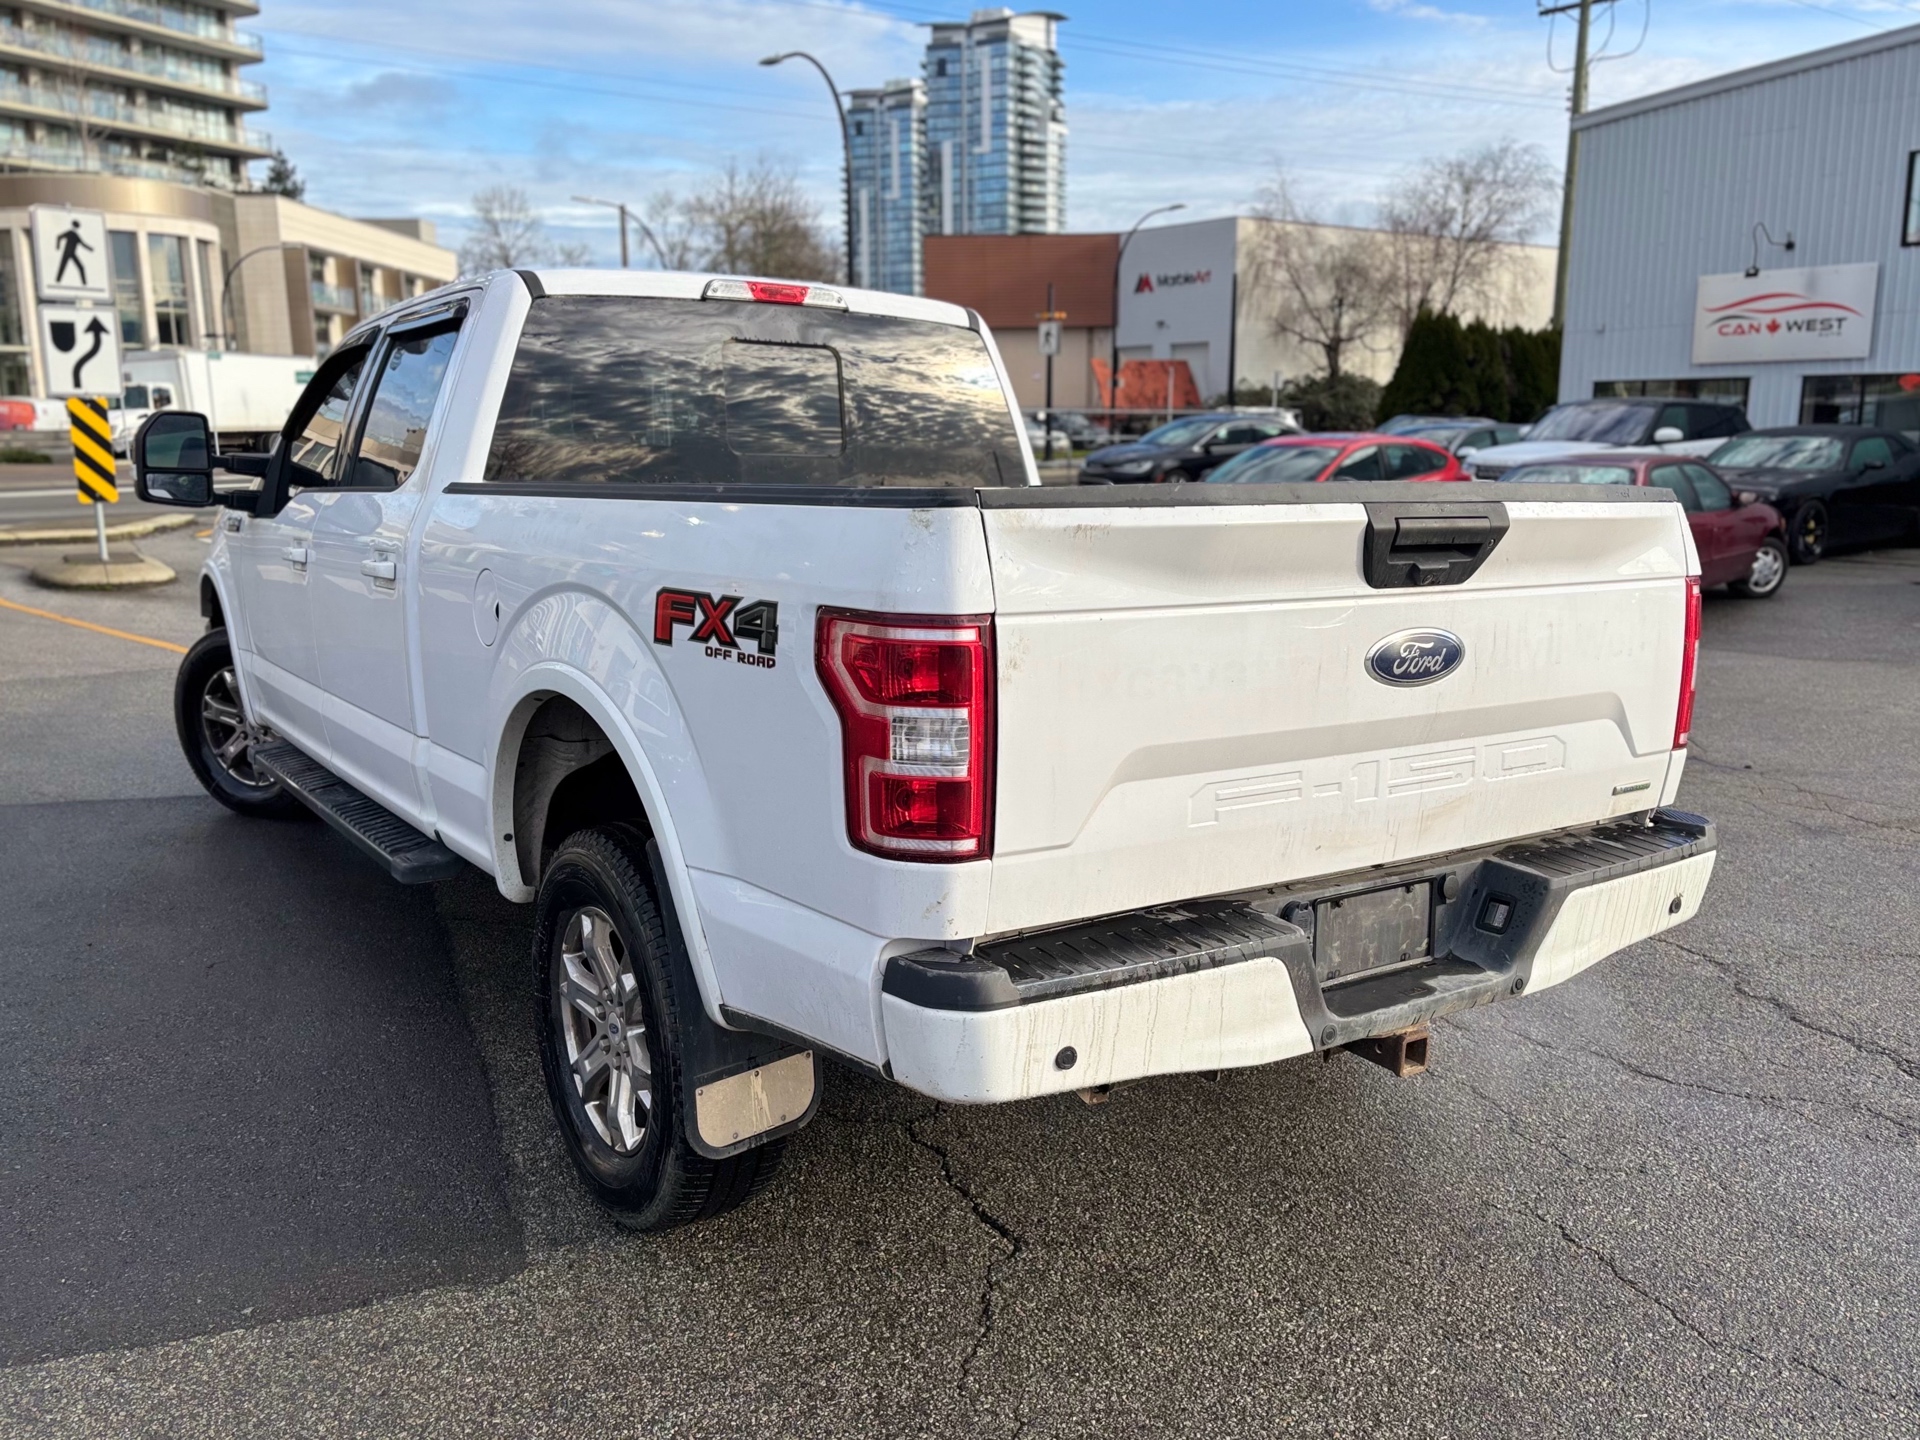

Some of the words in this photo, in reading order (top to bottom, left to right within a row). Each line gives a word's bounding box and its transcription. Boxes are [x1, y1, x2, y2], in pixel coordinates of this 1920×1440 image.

[1718, 323, 1761, 336] CAN
[1786, 317, 1847, 333] WEST
[653, 586, 778, 657] FX4
[705, 645, 732, 661] OFF
[737, 651, 776, 669] ROAD
[1393, 641, 1447, 675] Ford
[1188, 735, 1566, 828] F-150
